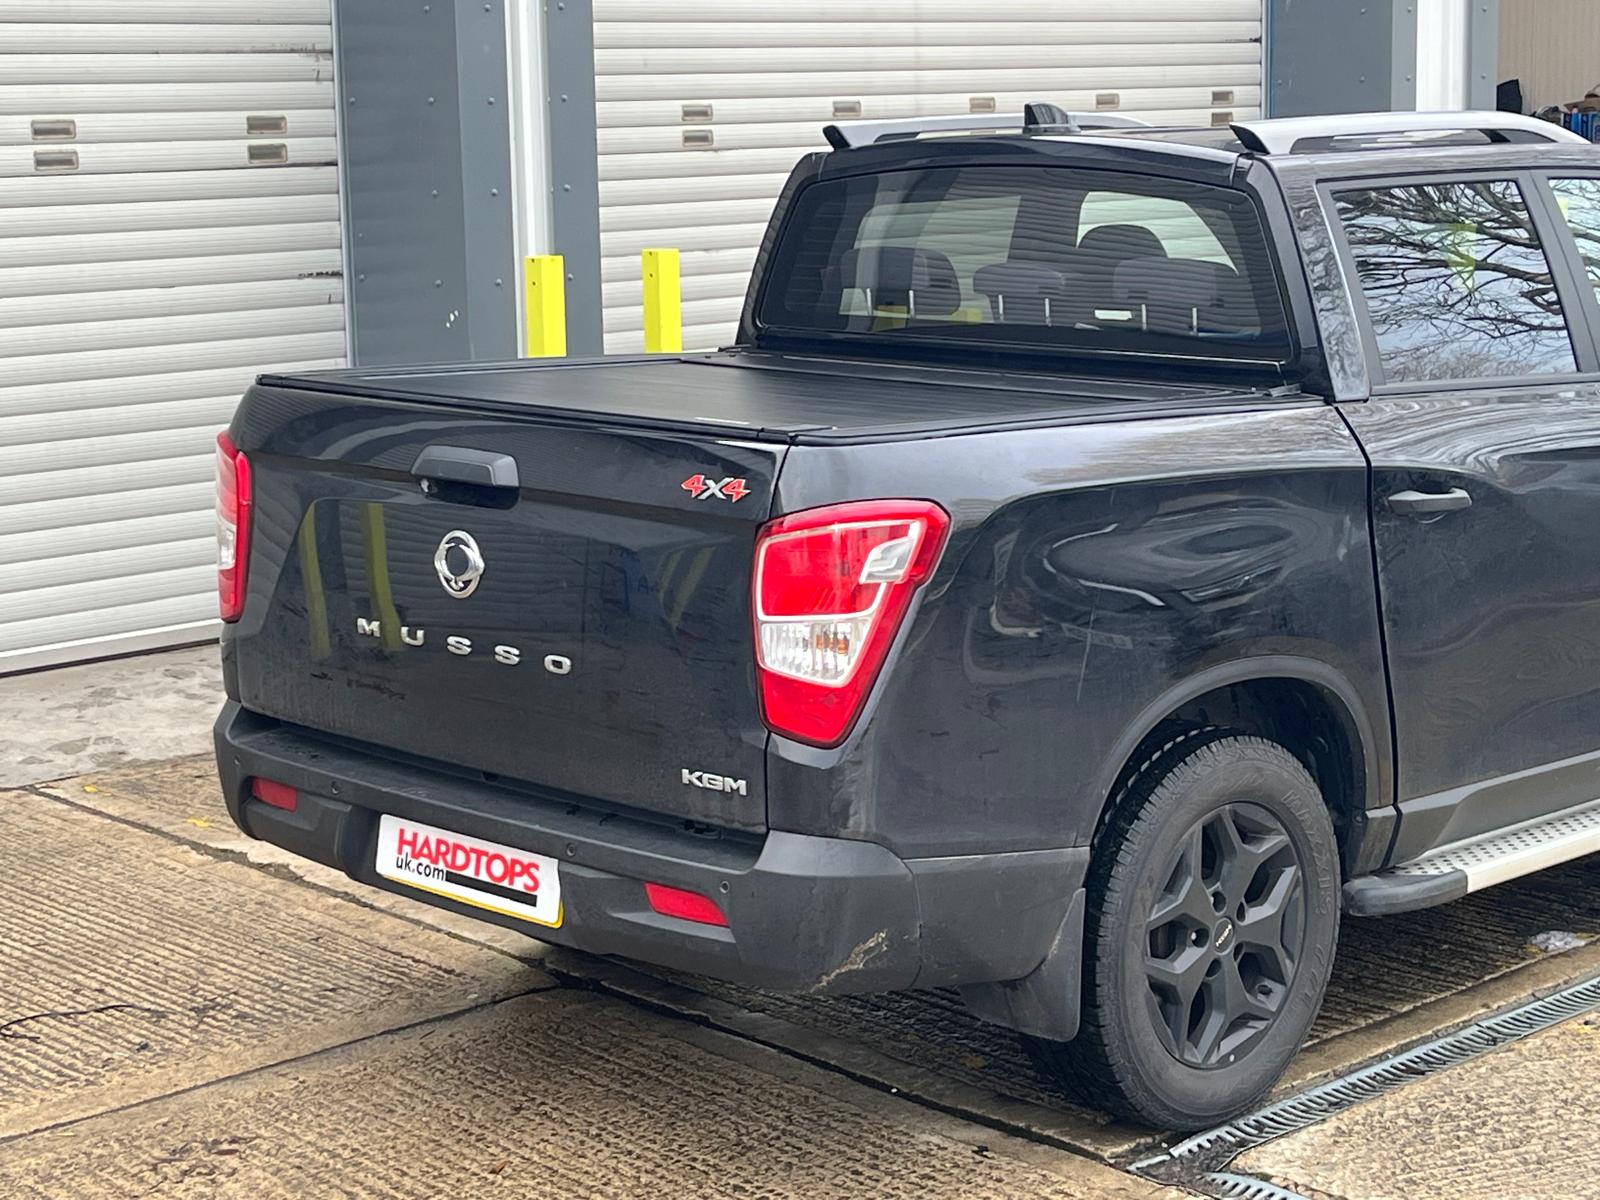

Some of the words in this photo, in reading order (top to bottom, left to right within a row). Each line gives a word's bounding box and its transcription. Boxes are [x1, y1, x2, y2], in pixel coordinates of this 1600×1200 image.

[356, 617, 572, 675] MUSSO
[681, 768, 747, 796] KGM
[395, 853, 446, 882] uk.com
[397, 828, 540, 893] HARDTOPS
